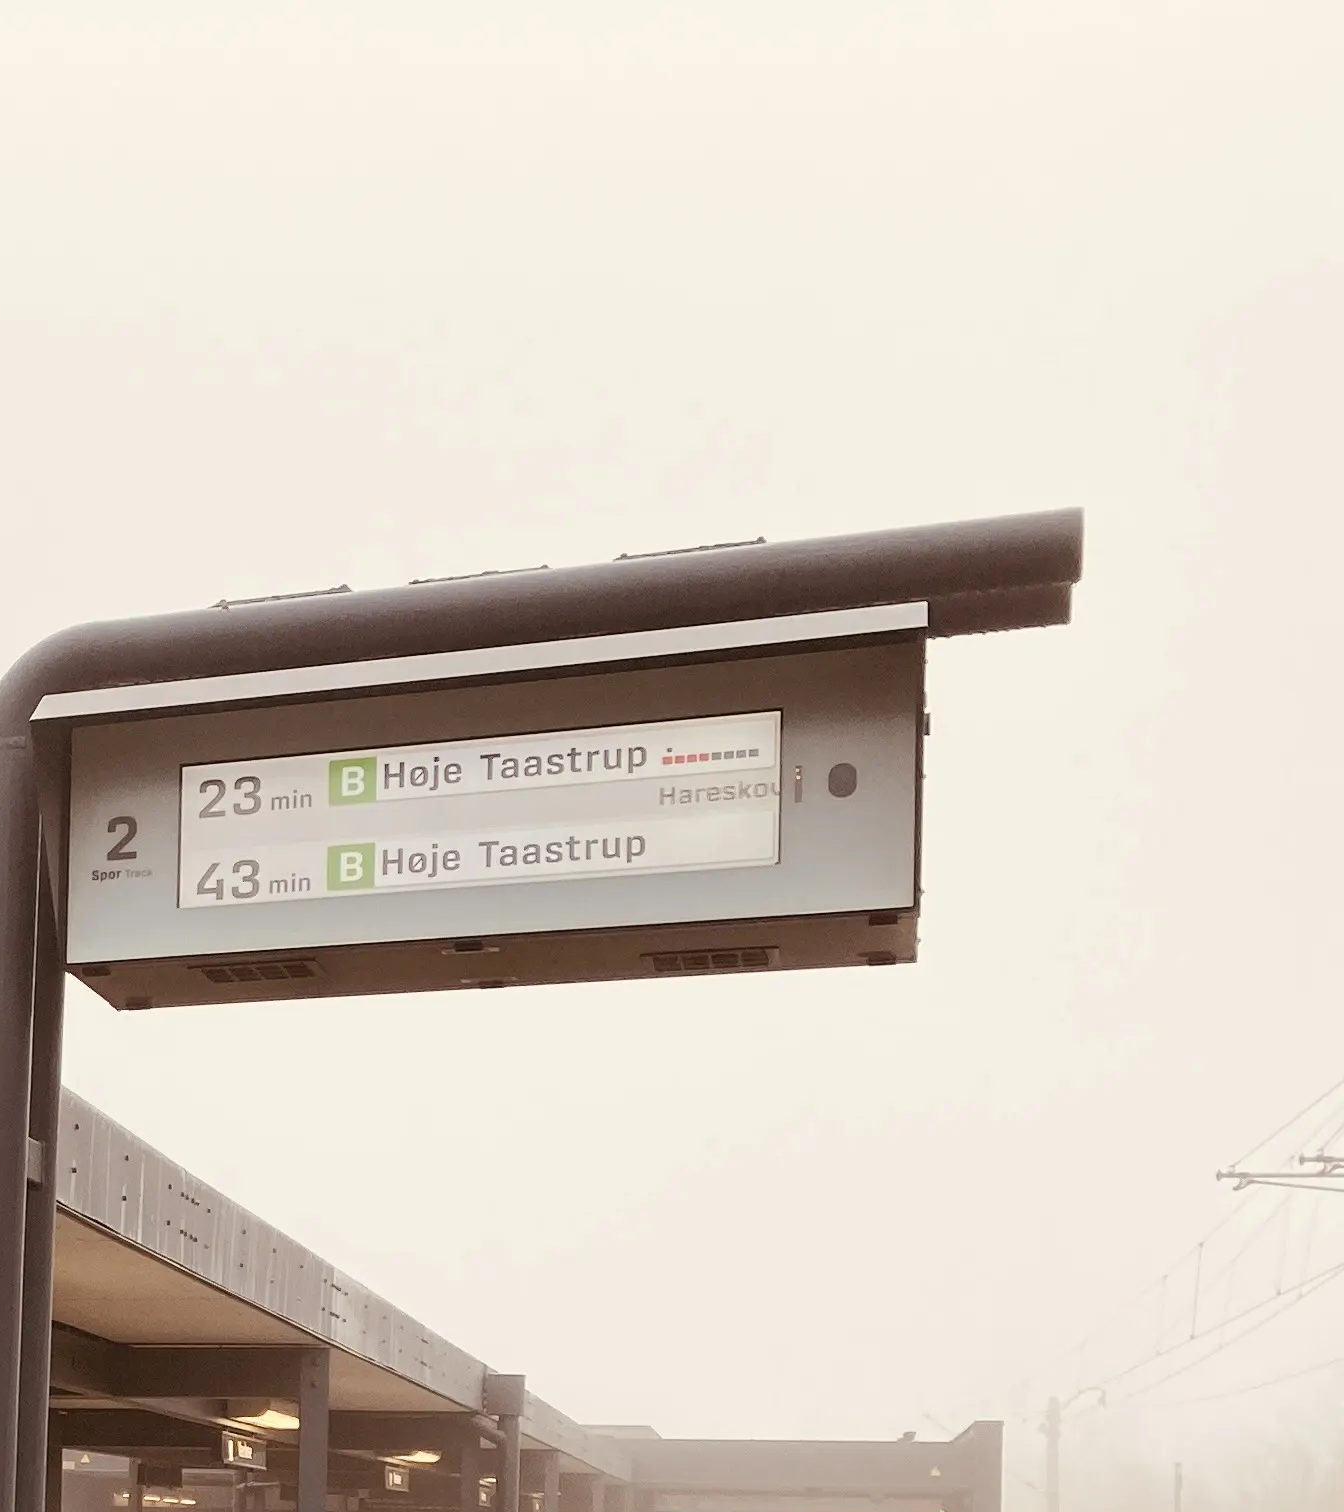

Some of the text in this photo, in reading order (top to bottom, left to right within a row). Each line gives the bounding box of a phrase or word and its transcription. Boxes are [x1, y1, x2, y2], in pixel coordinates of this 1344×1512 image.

[198, 744, 648, 819] 23 min B Høje Taastrup
[106, 815, 138, 861] 2
[91, 870, 122, 882] Spor
[196, 834, 647, 901] 43 min B Høje Taastrup
